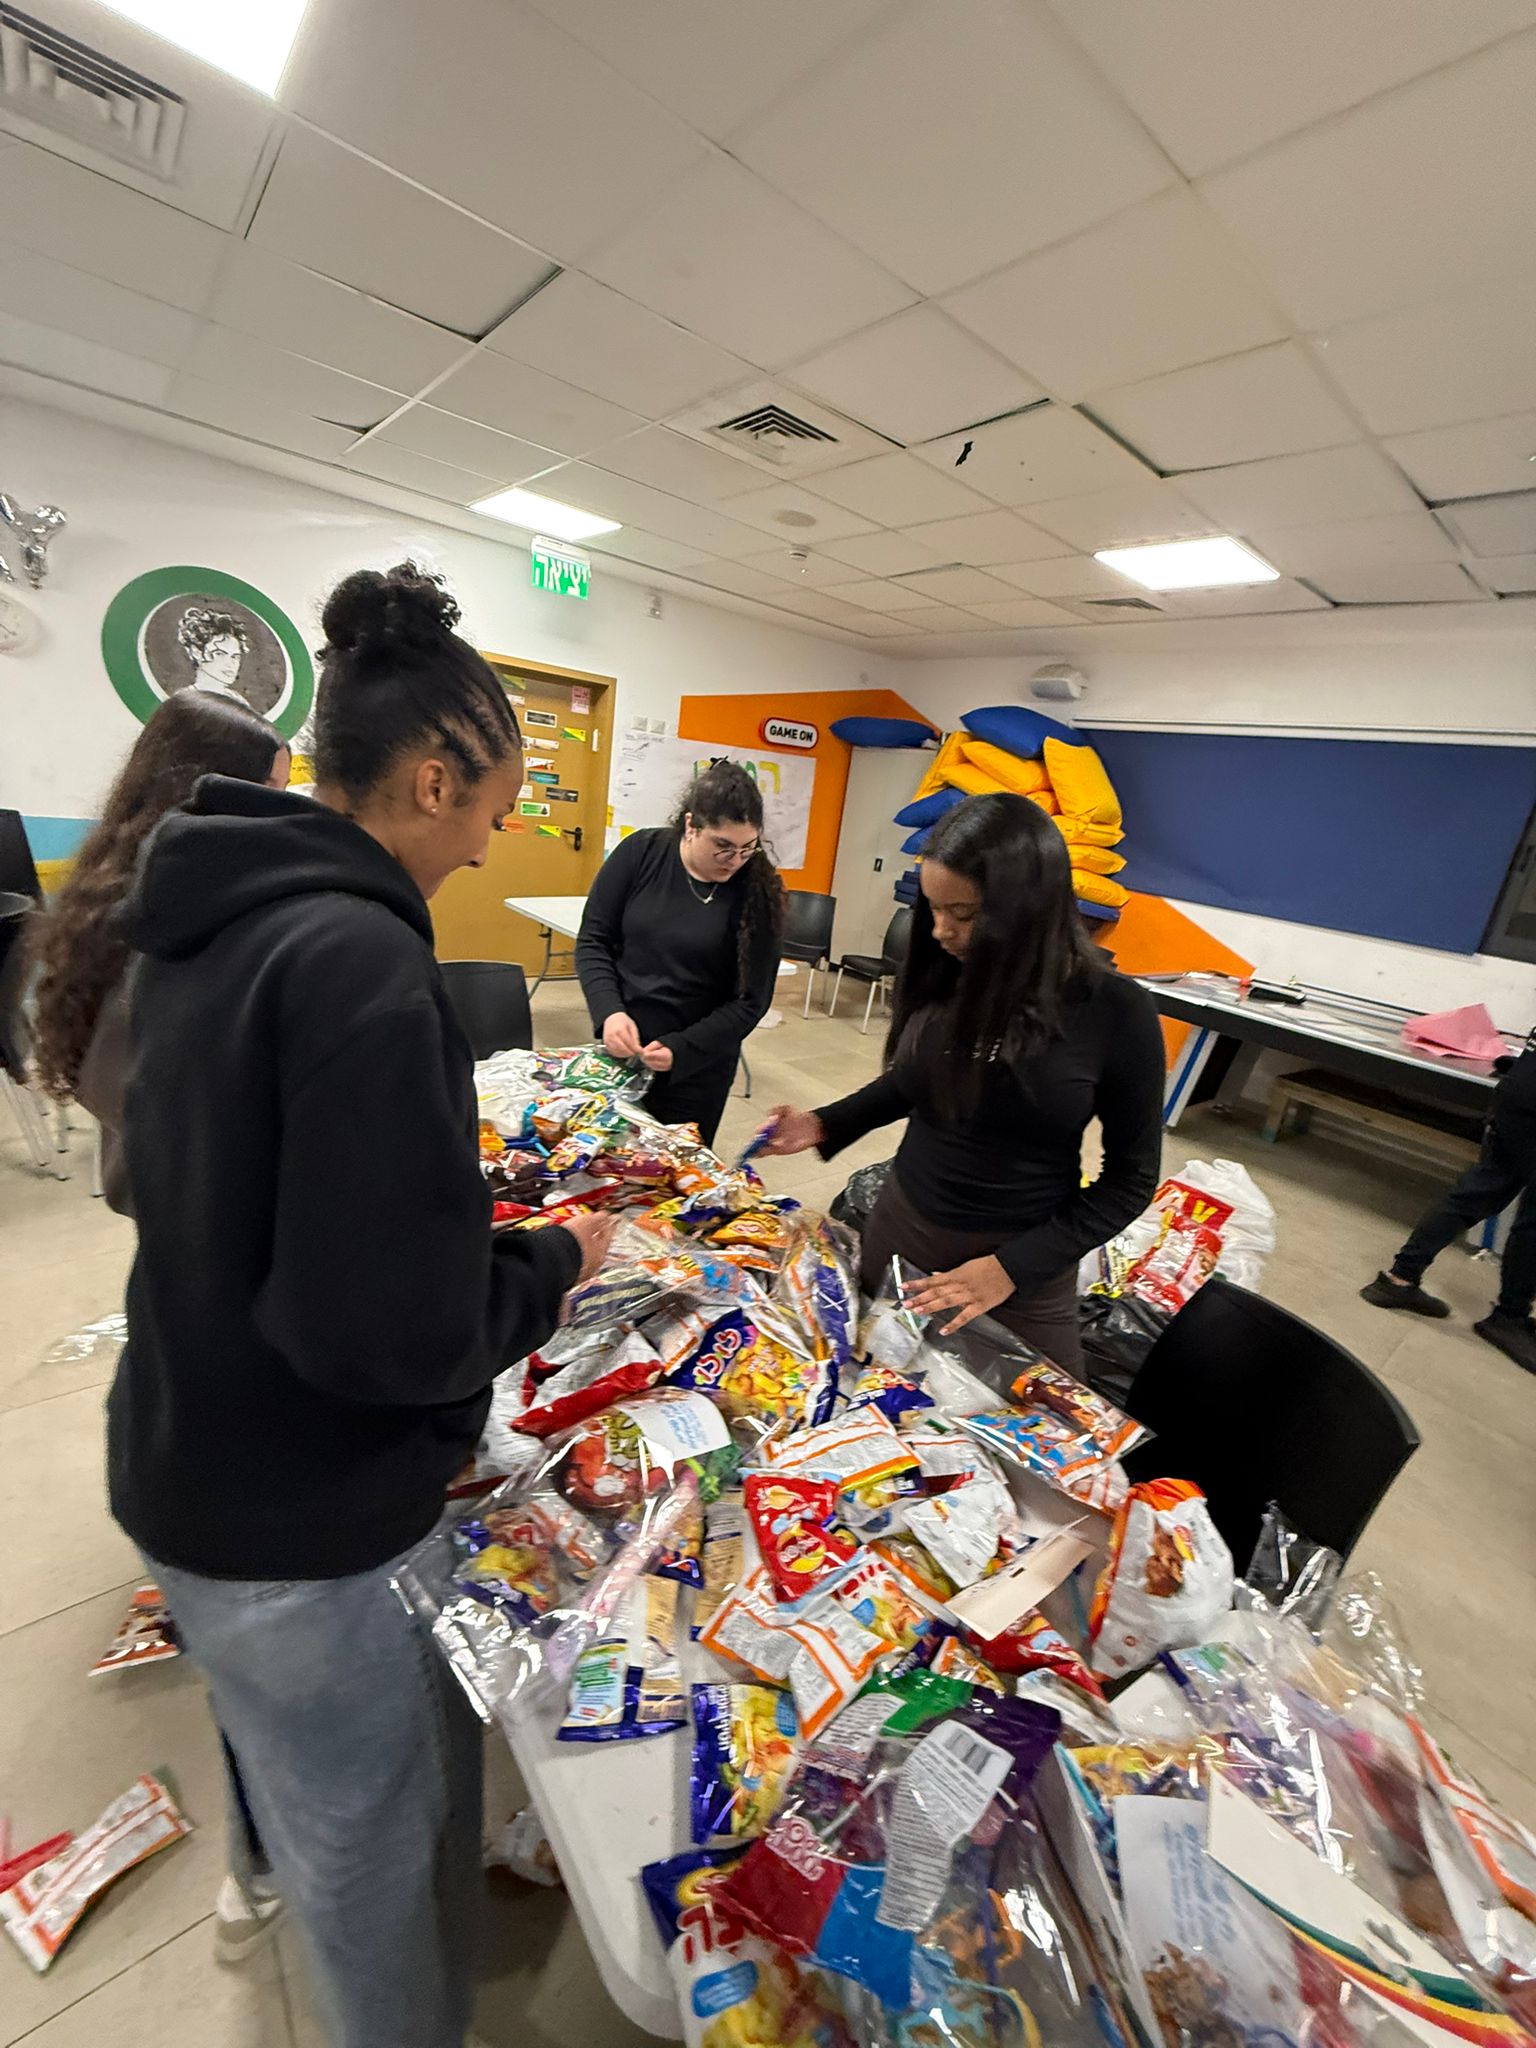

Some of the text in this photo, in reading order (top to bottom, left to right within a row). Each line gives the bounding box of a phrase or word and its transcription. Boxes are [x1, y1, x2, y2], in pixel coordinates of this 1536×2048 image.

[535, 553, 589, 598] יציאה
[769, 725, 813, 742] GAME ON
